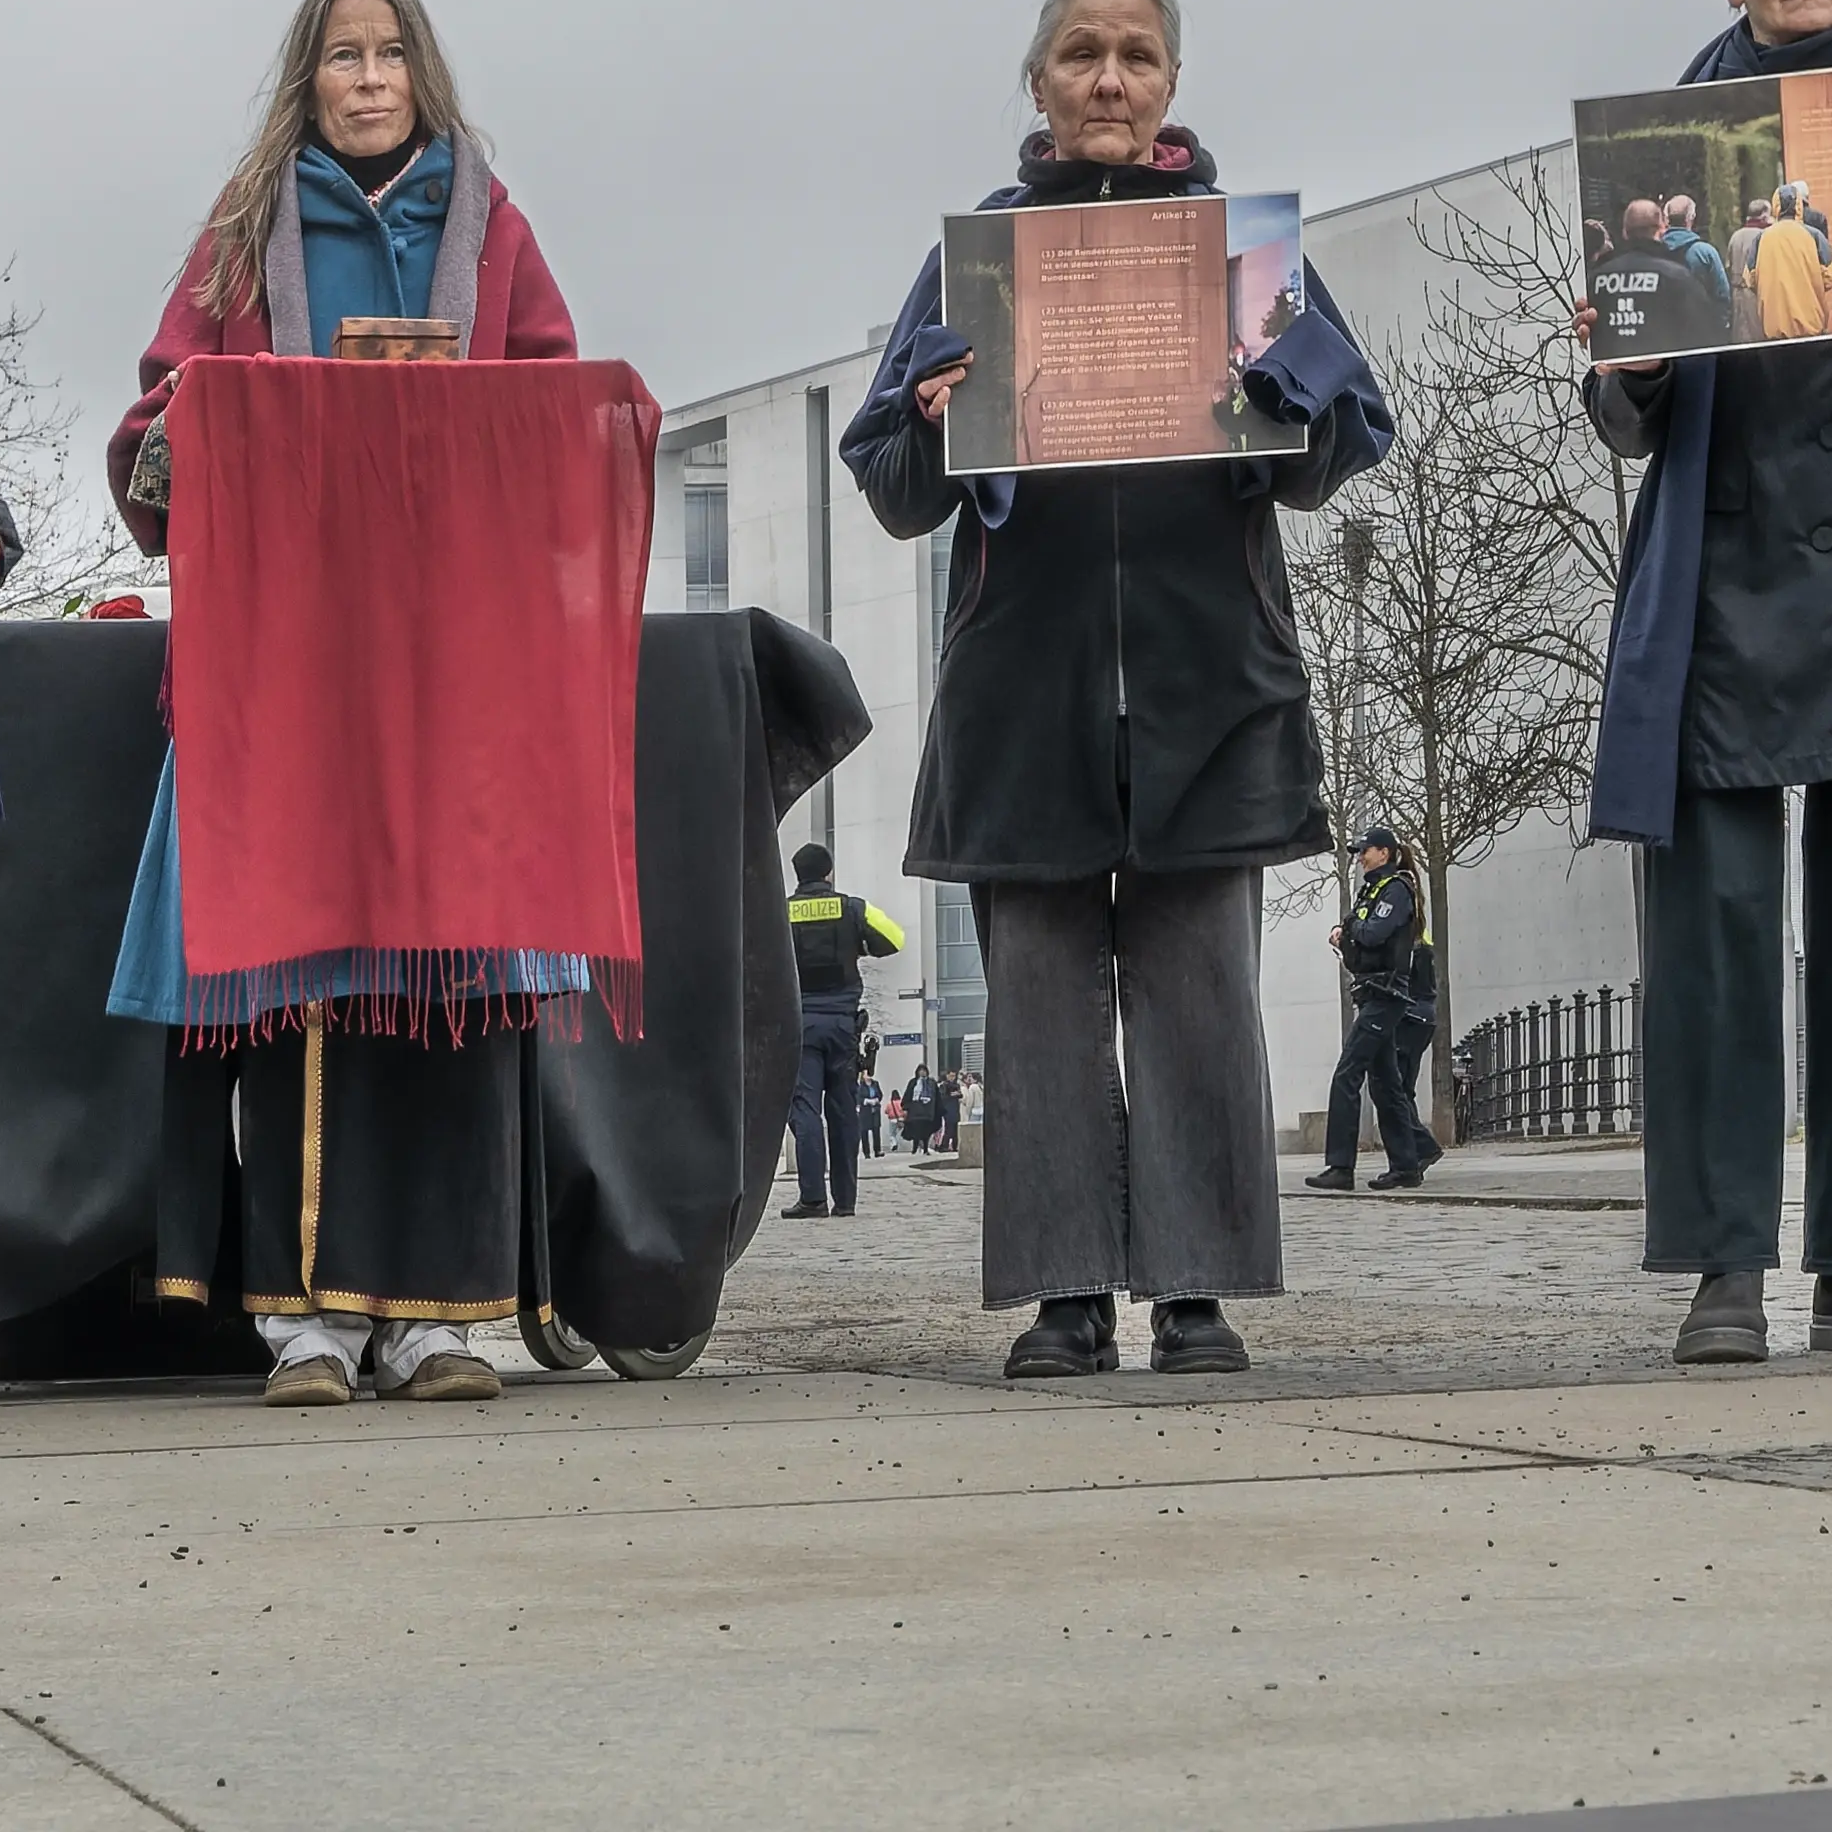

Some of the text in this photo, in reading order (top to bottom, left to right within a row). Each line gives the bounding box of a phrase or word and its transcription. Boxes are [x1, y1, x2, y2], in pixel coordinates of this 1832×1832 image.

[1152, 211, 1196, 221] Artikel 20
[1595, 272, 1659, 294] POLIZEI
[792, 900, 839, 919] POLIZEI
